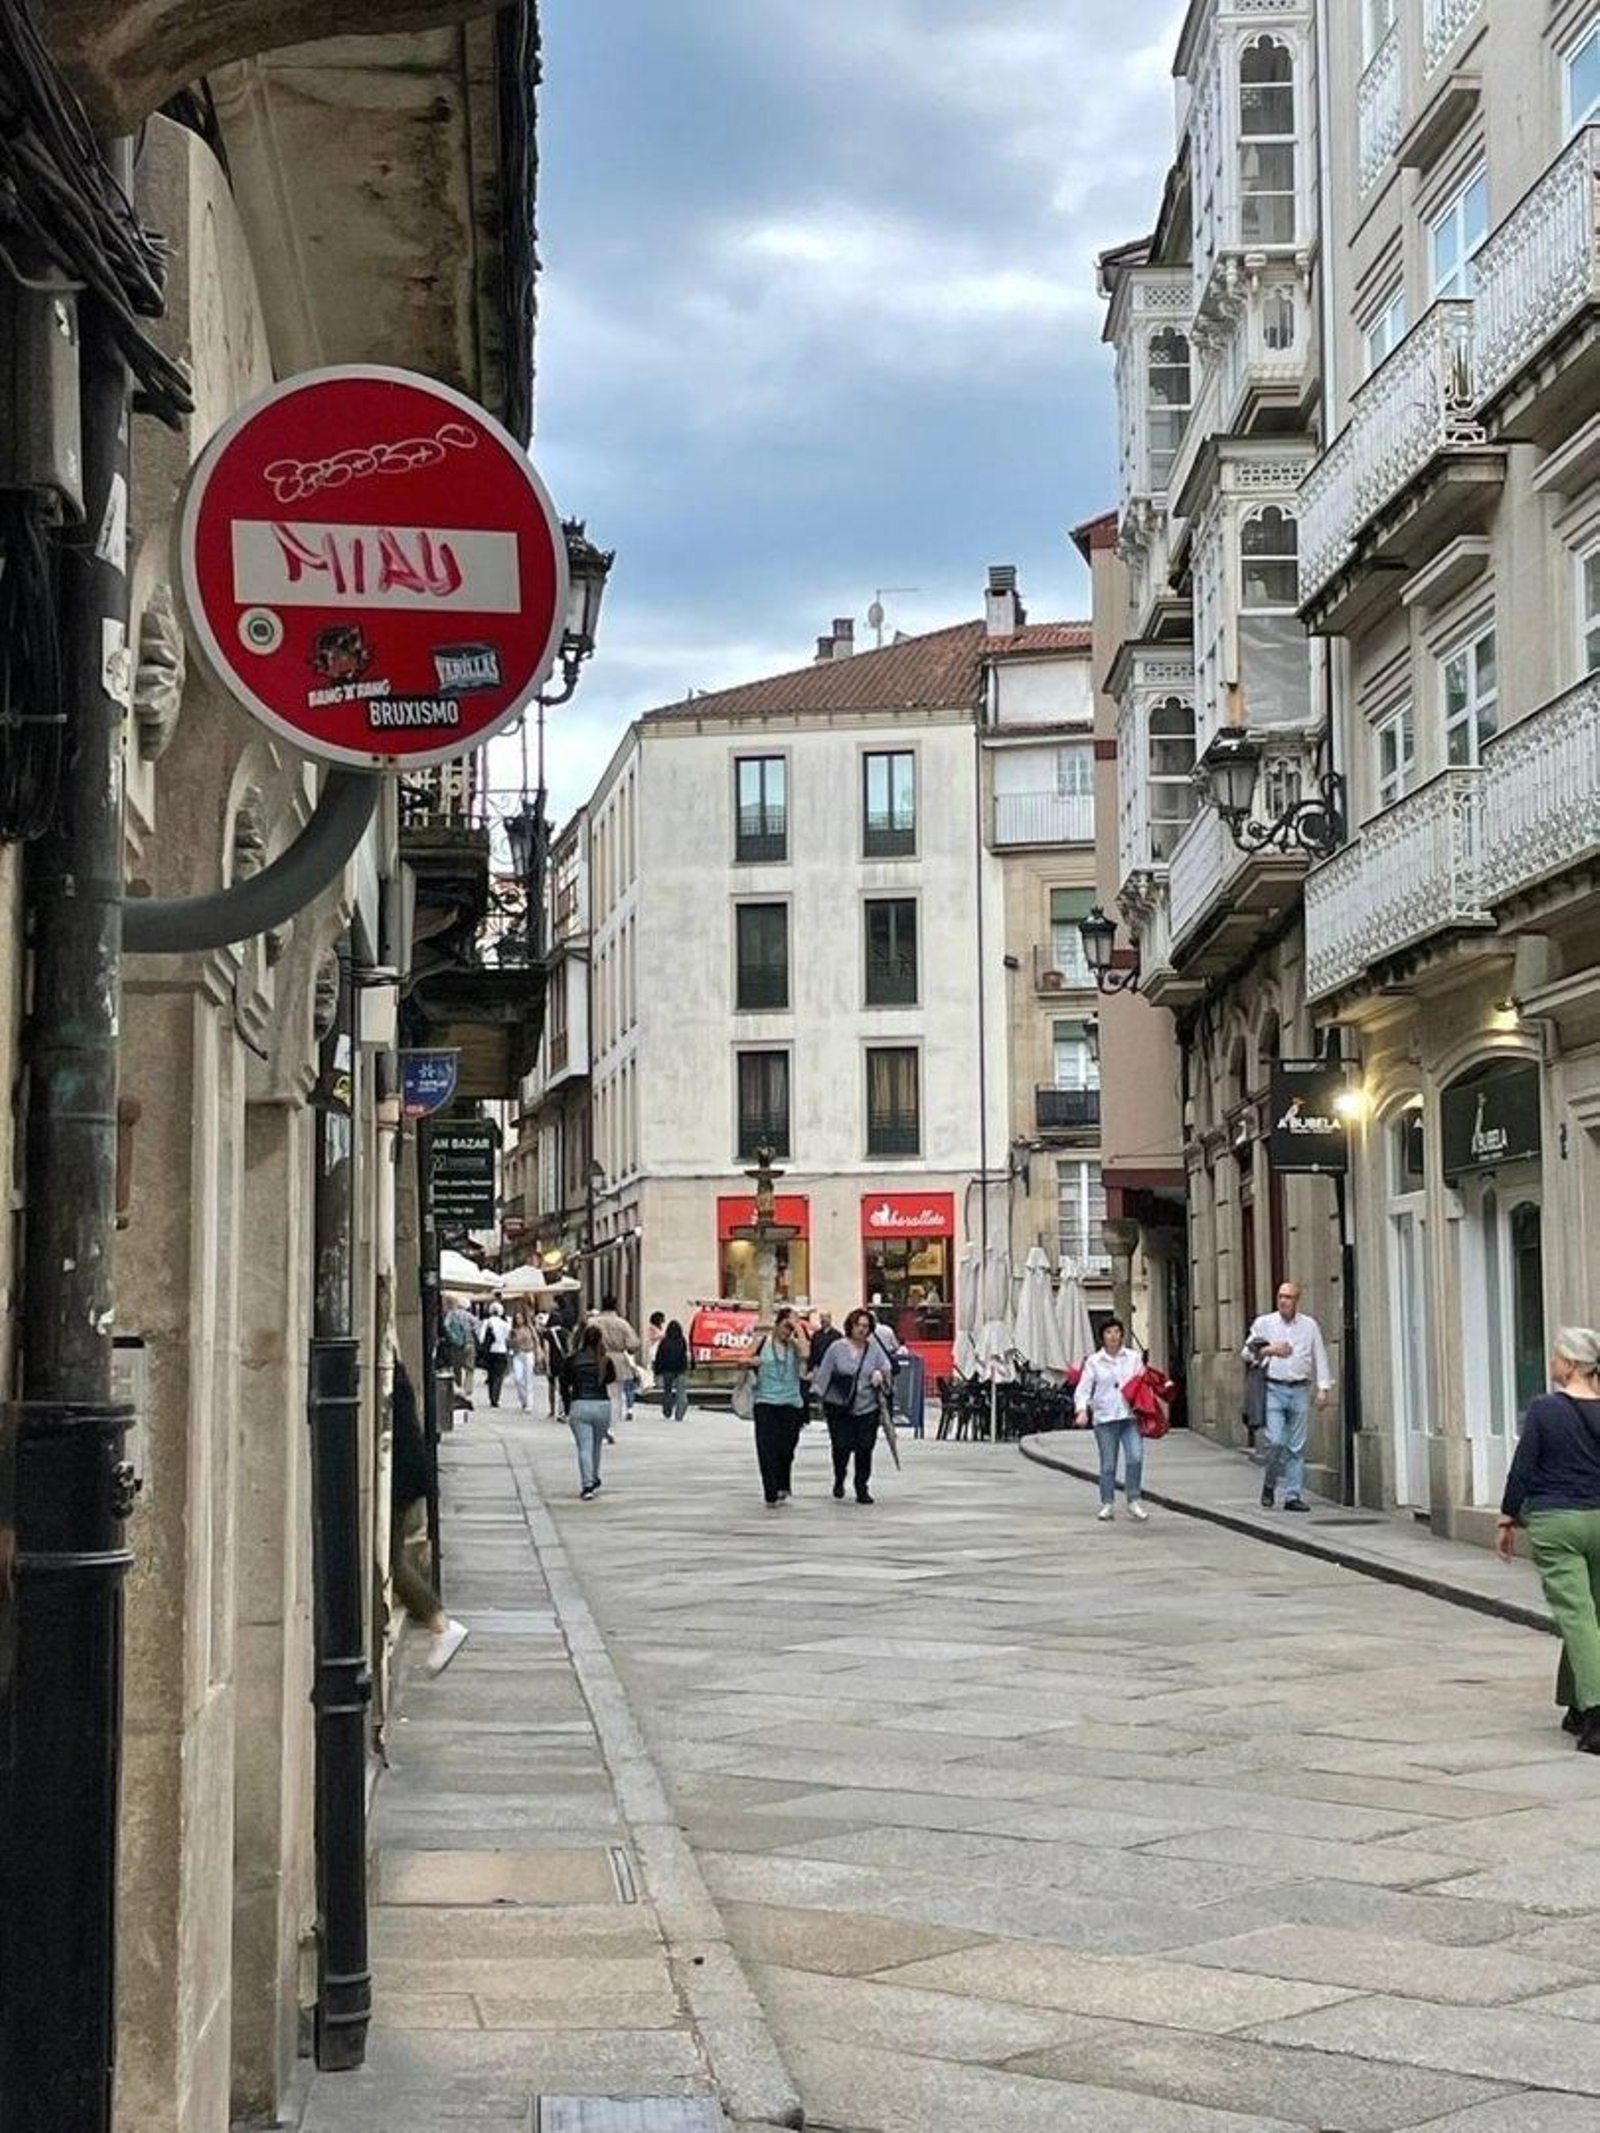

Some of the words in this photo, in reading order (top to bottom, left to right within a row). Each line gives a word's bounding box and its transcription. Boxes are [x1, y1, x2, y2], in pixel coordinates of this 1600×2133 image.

[271, 522, 462, 597] MIAU
[369, 700, 459, 726] BRUXISMO
[451, 1138, 490, 1150] BAZAR
